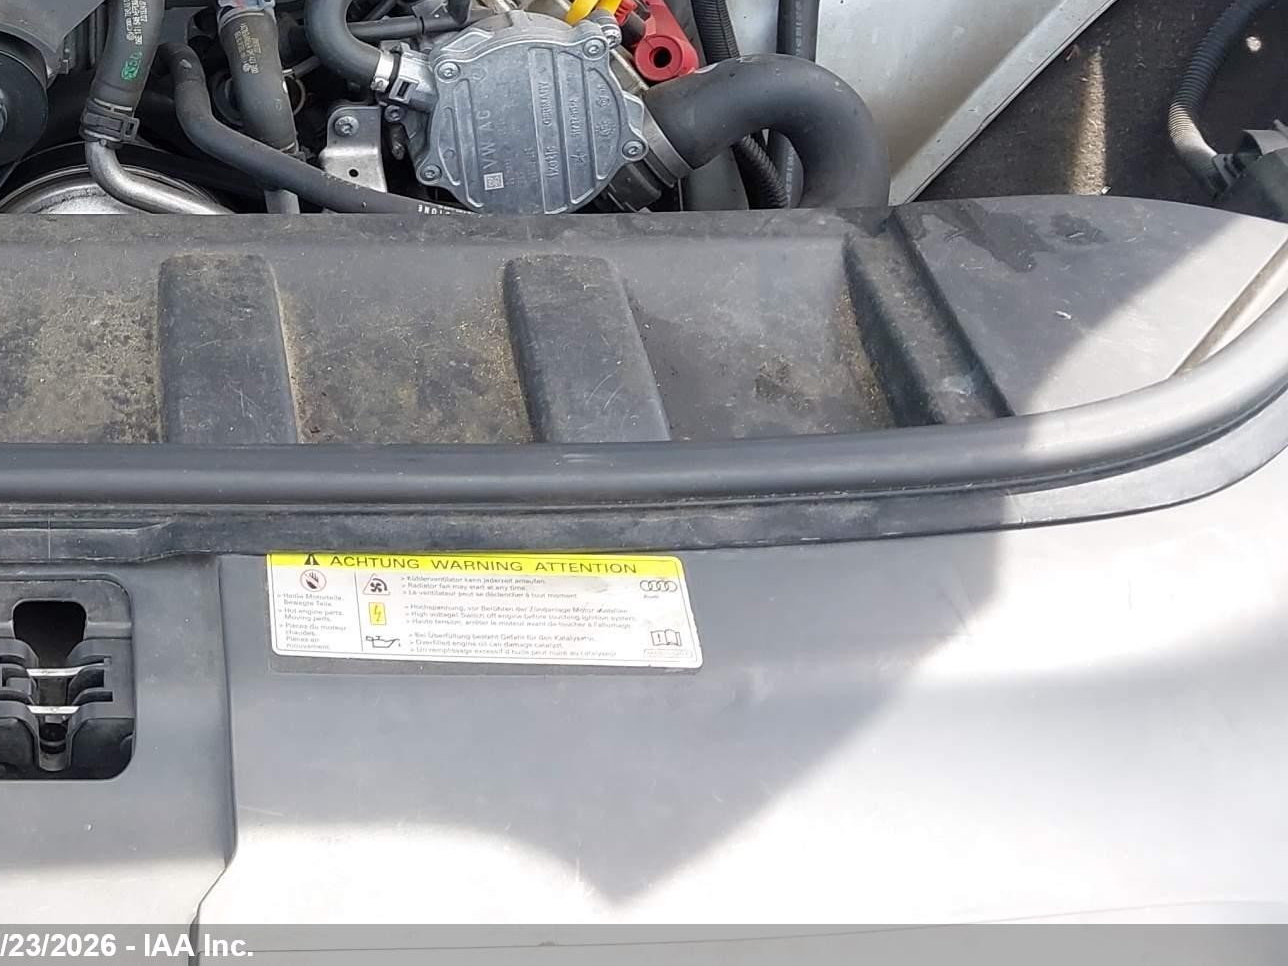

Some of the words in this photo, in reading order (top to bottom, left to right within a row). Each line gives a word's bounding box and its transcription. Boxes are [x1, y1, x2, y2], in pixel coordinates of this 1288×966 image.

[476, 110, 492, 130] AG
[480, 141, 498, 170] VW
[330, 556, 420, 569] ACHTUNG
[431, 560, 523, 571] WARNING
[535, 562, 637, 574] ATTENTION
